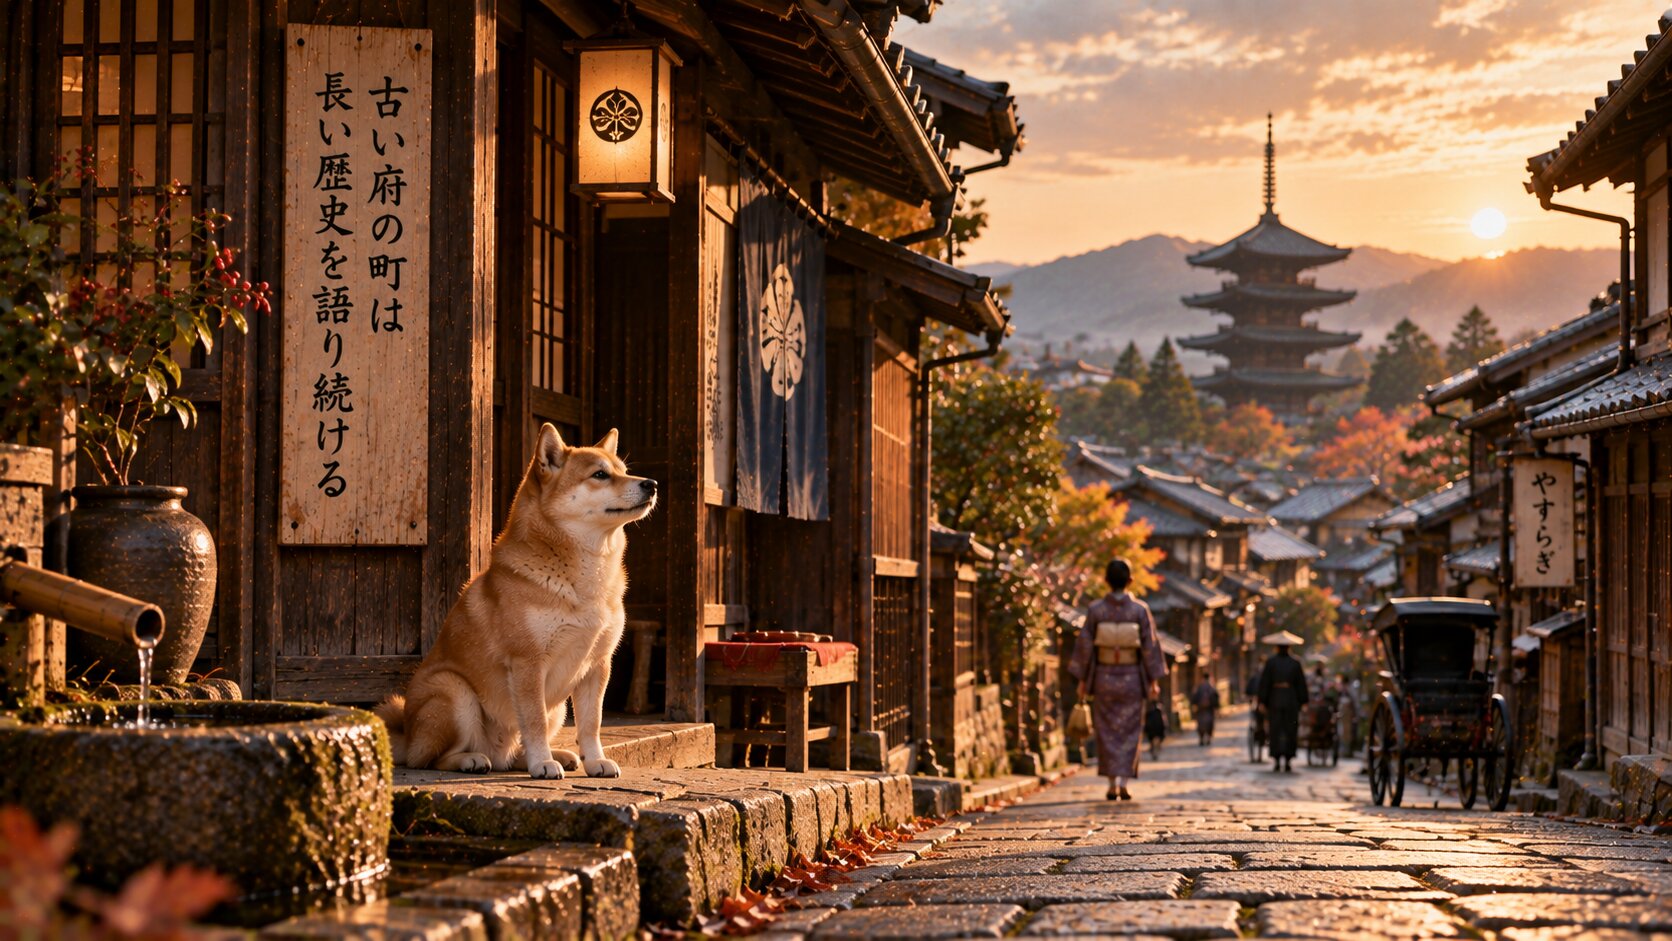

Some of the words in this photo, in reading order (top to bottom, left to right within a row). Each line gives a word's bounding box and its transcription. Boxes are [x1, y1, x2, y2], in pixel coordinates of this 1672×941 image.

[312, 71, 354, 497] 長い歴史を語り続ける
[367, 75, 409, 333] 古い府の町は
[1531, 471, 1557, 575] やすらぎ
